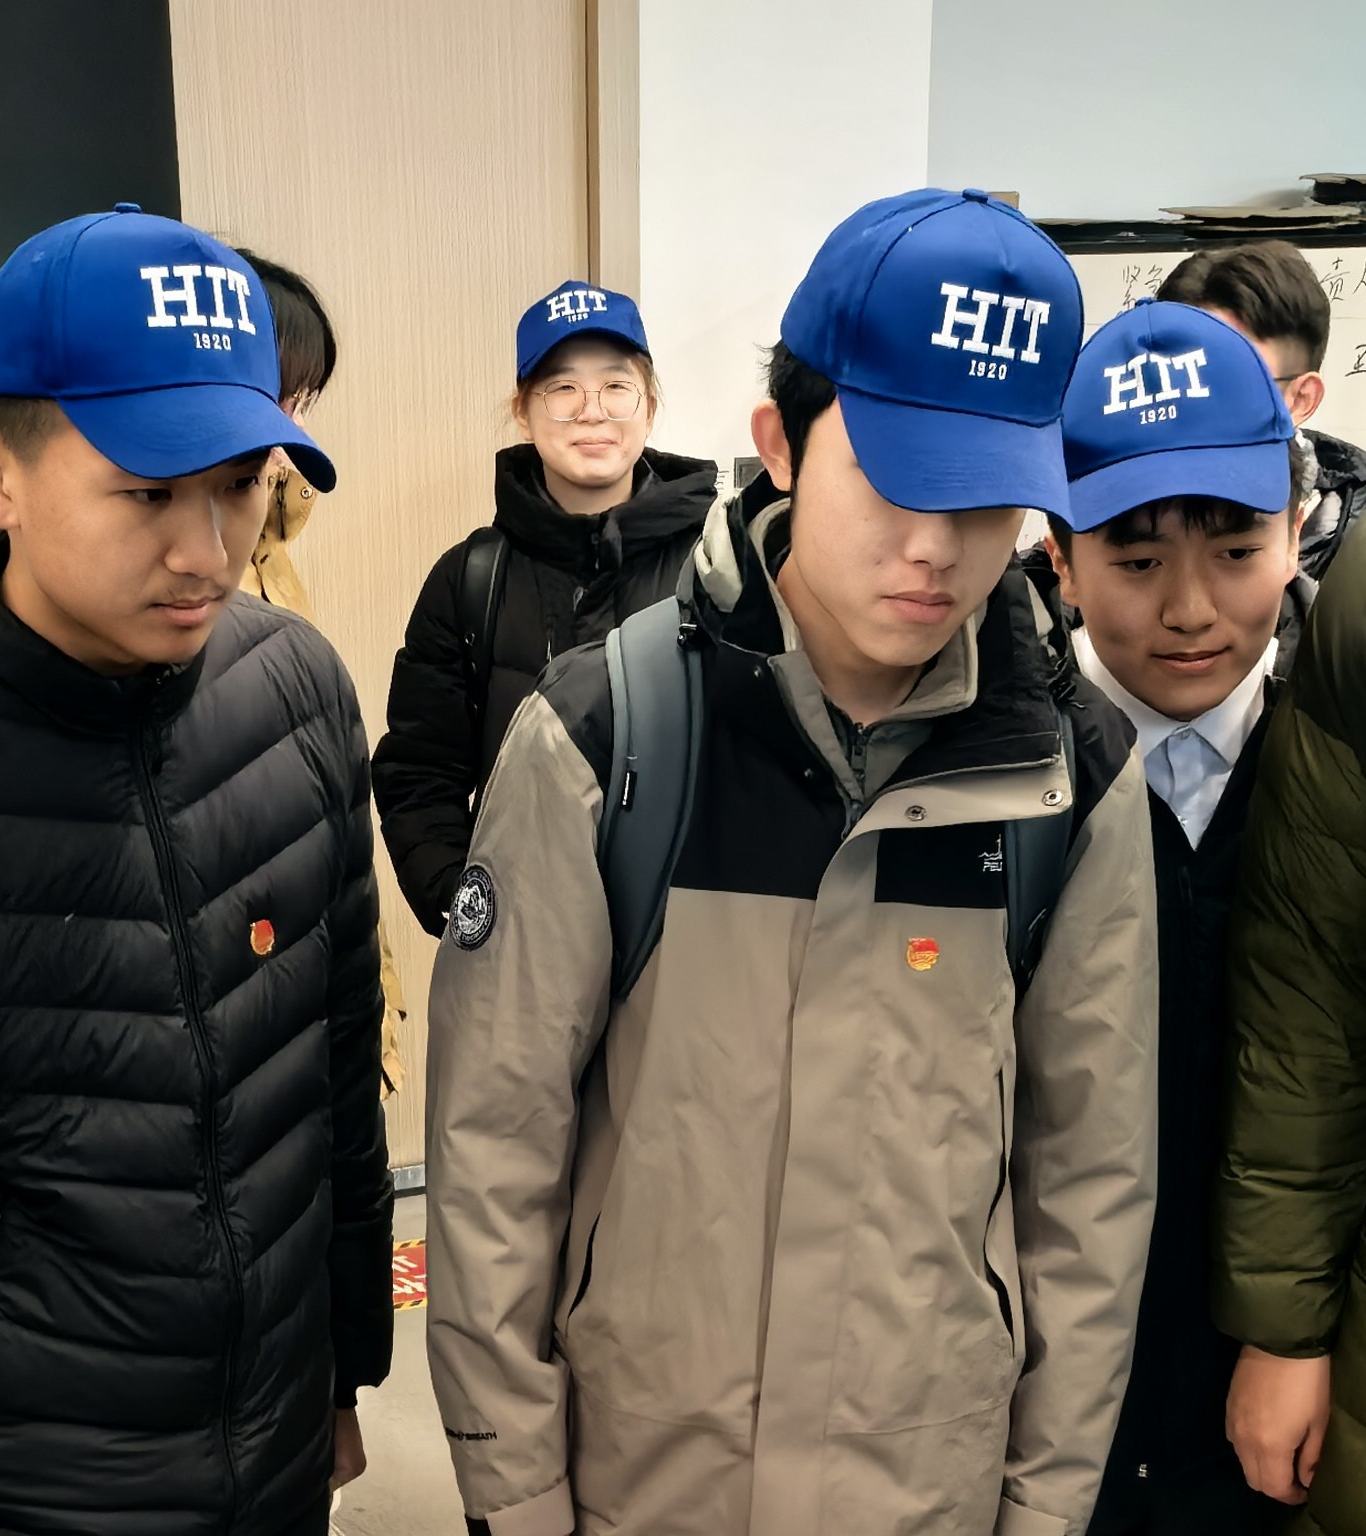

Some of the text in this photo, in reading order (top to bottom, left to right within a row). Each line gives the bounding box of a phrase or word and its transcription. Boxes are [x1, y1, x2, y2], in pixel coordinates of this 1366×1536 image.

[139, 265, 257, 334] HIT
[546, 290, 608, 322] HIT
[930, 282, 1051, 365] HIT
[192, 332, 232, 351] 1920
[968, 358, 1008, 381] 1920
[1103, 348, 1210, 417] HIT
[1138, 402, 1178, 426] 1920
